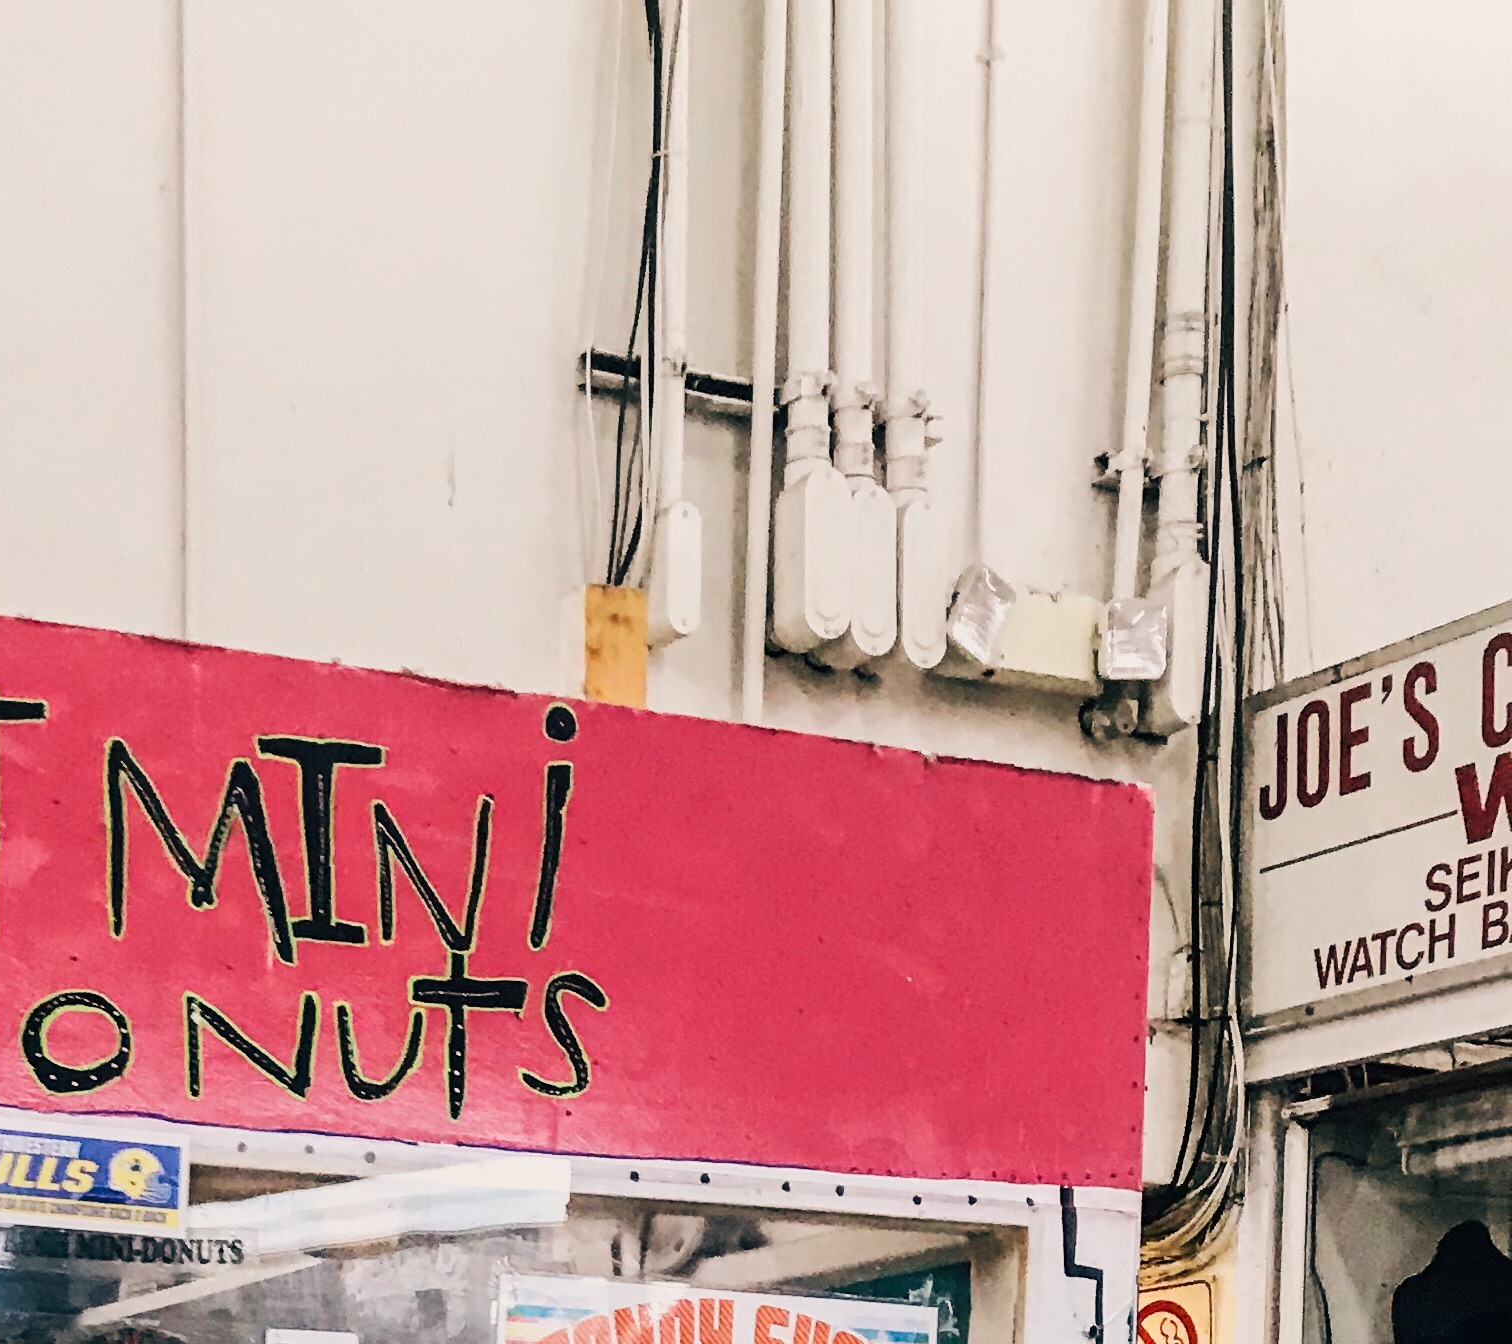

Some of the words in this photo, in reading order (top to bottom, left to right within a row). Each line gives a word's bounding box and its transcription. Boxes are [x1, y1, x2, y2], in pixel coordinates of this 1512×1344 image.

[1259, 660, 1440, 821] JOE'S
[1314, 913, 1456, 989] WATCH
[1482, 900, 1512, 950] B
